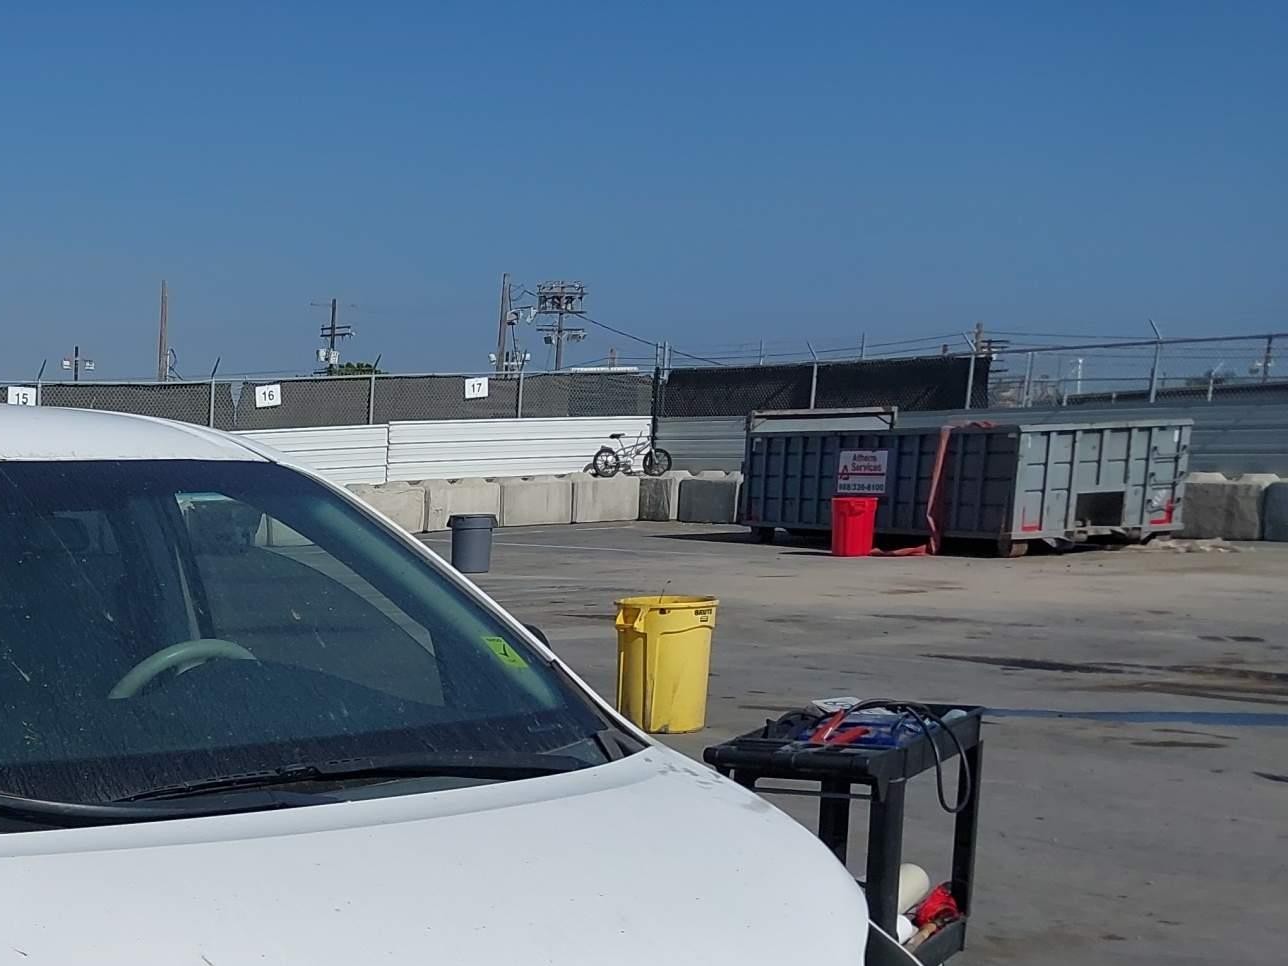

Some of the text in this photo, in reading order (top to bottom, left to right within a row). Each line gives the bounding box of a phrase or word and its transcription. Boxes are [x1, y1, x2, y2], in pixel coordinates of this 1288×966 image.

[470, 382, 482, 393] 17
[15, 392, 29, 405] 15
[261, 390, 275, 402] 16
[850, 463, 882, 472] Services
